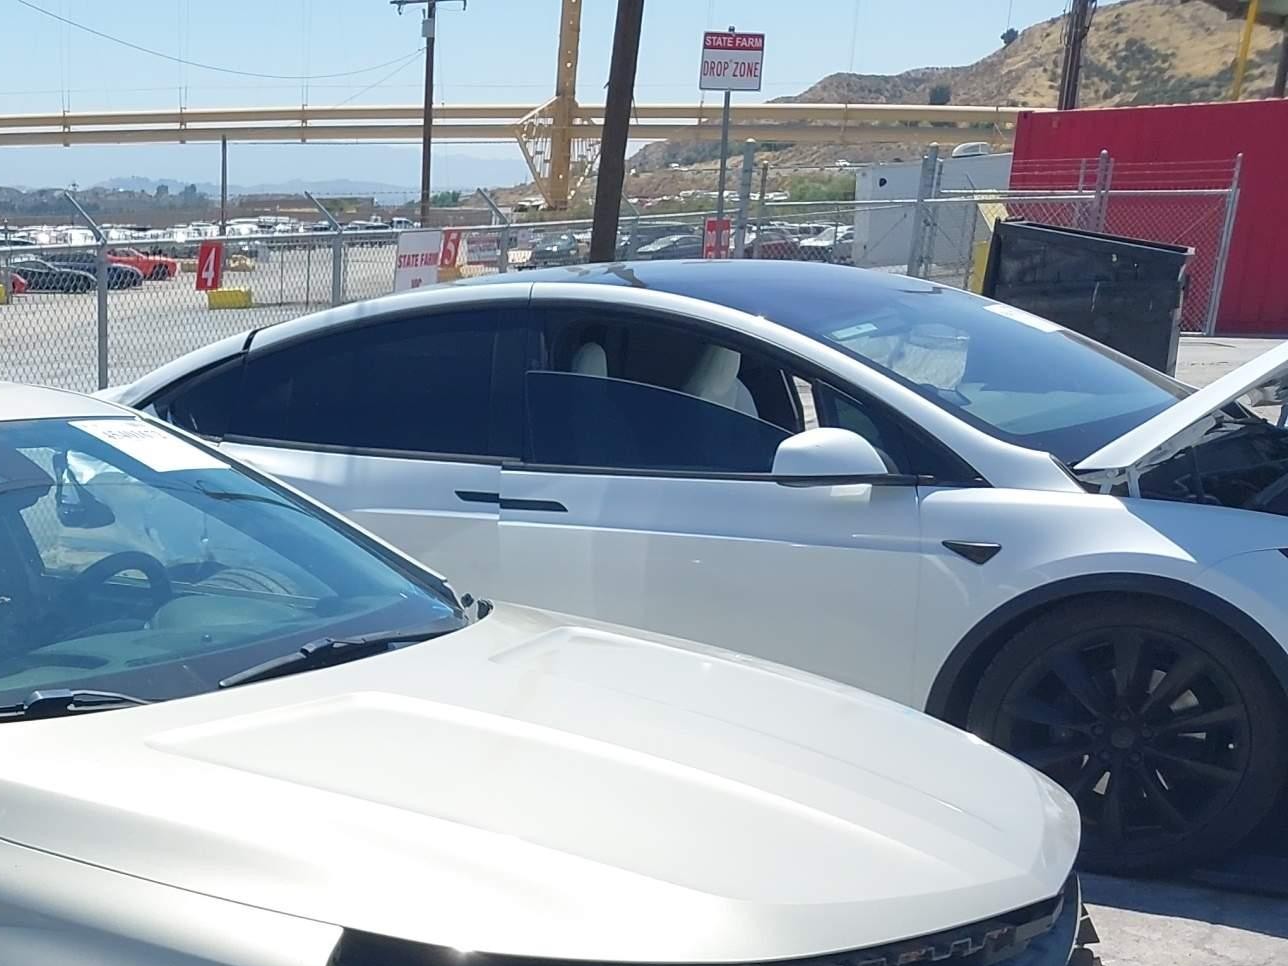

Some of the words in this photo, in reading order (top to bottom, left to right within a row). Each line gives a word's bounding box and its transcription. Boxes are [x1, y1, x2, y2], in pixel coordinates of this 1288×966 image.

[704, 36, 734, 47] STATE
[735, 37, 763, 48] FARM
[703, 60, 730, 77] DROP
[732, 61, 760, 78] ZONE
[444, 232, 458, 265] 5
[201, 247, 216, 287] 4
[398, 254, 419, 269] STATE
